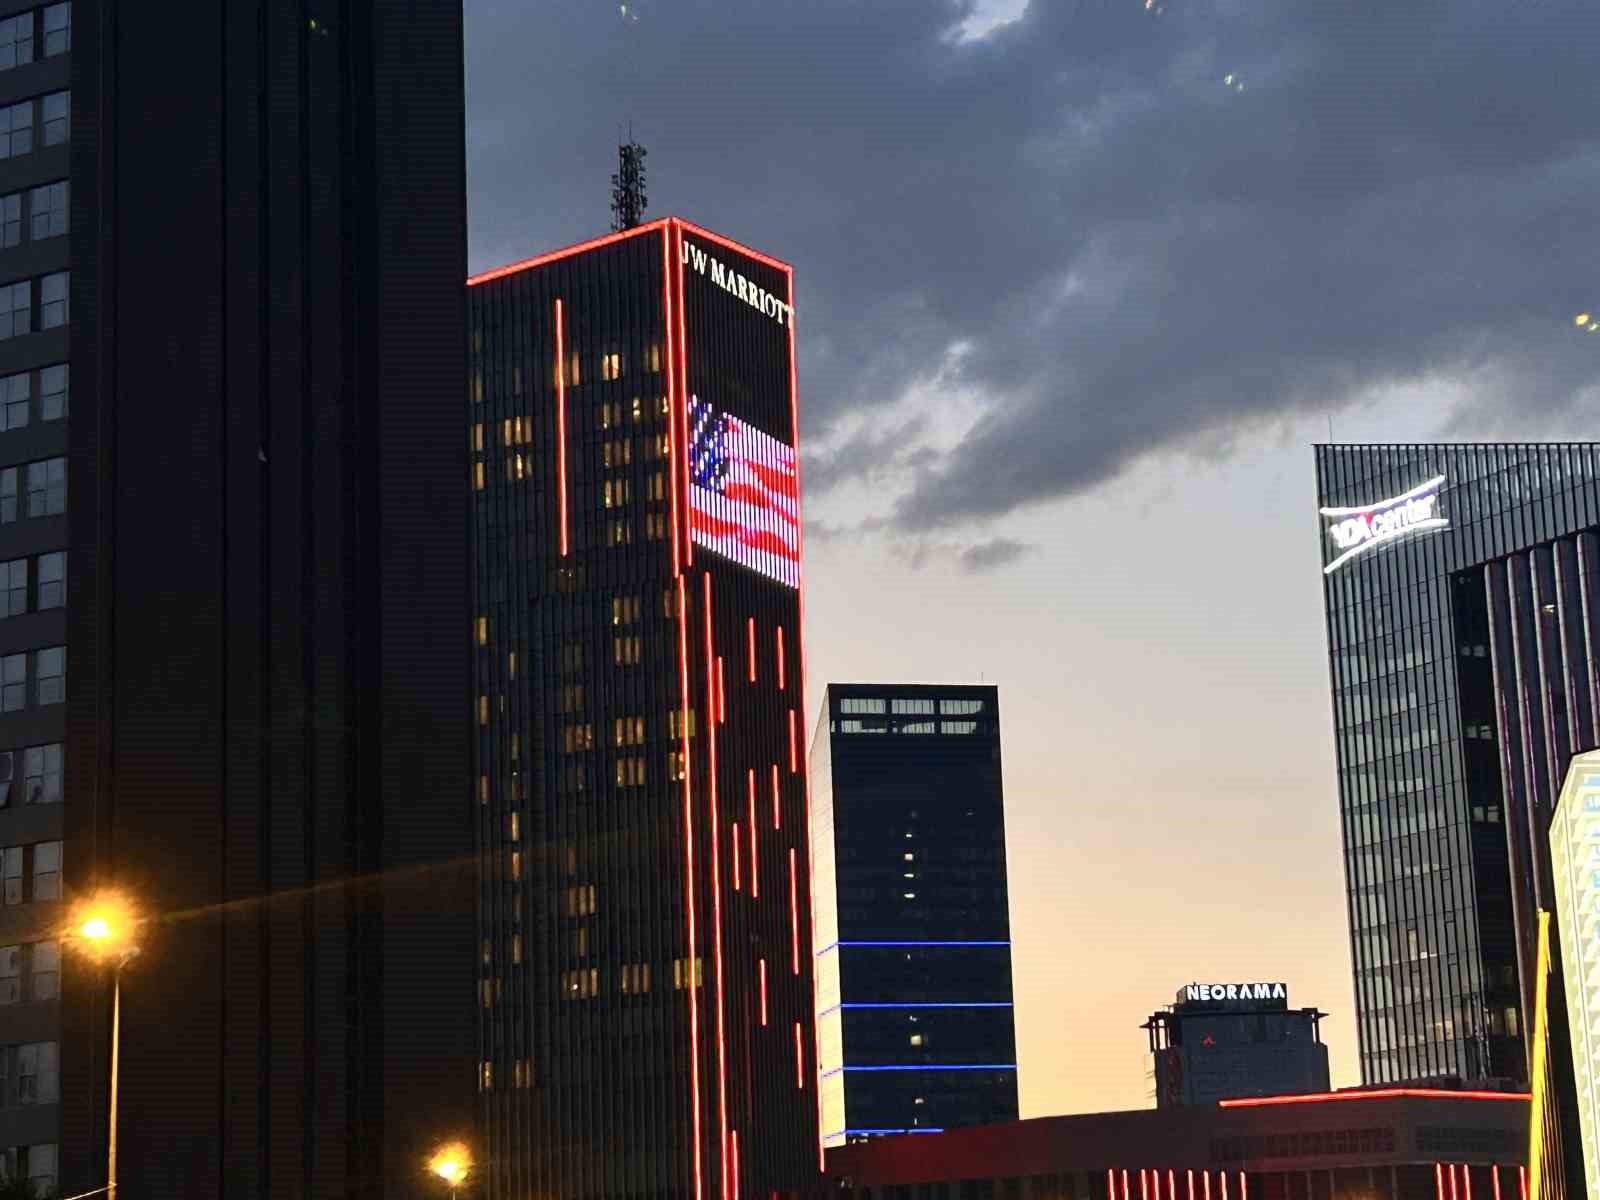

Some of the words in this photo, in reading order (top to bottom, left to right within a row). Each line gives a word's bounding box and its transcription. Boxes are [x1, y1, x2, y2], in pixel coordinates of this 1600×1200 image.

[682, 240, 708, 275] JW
[710, 257, 795, 328] MARRIOTT
[1186, 983, 1285, 1001] NEORAMA
